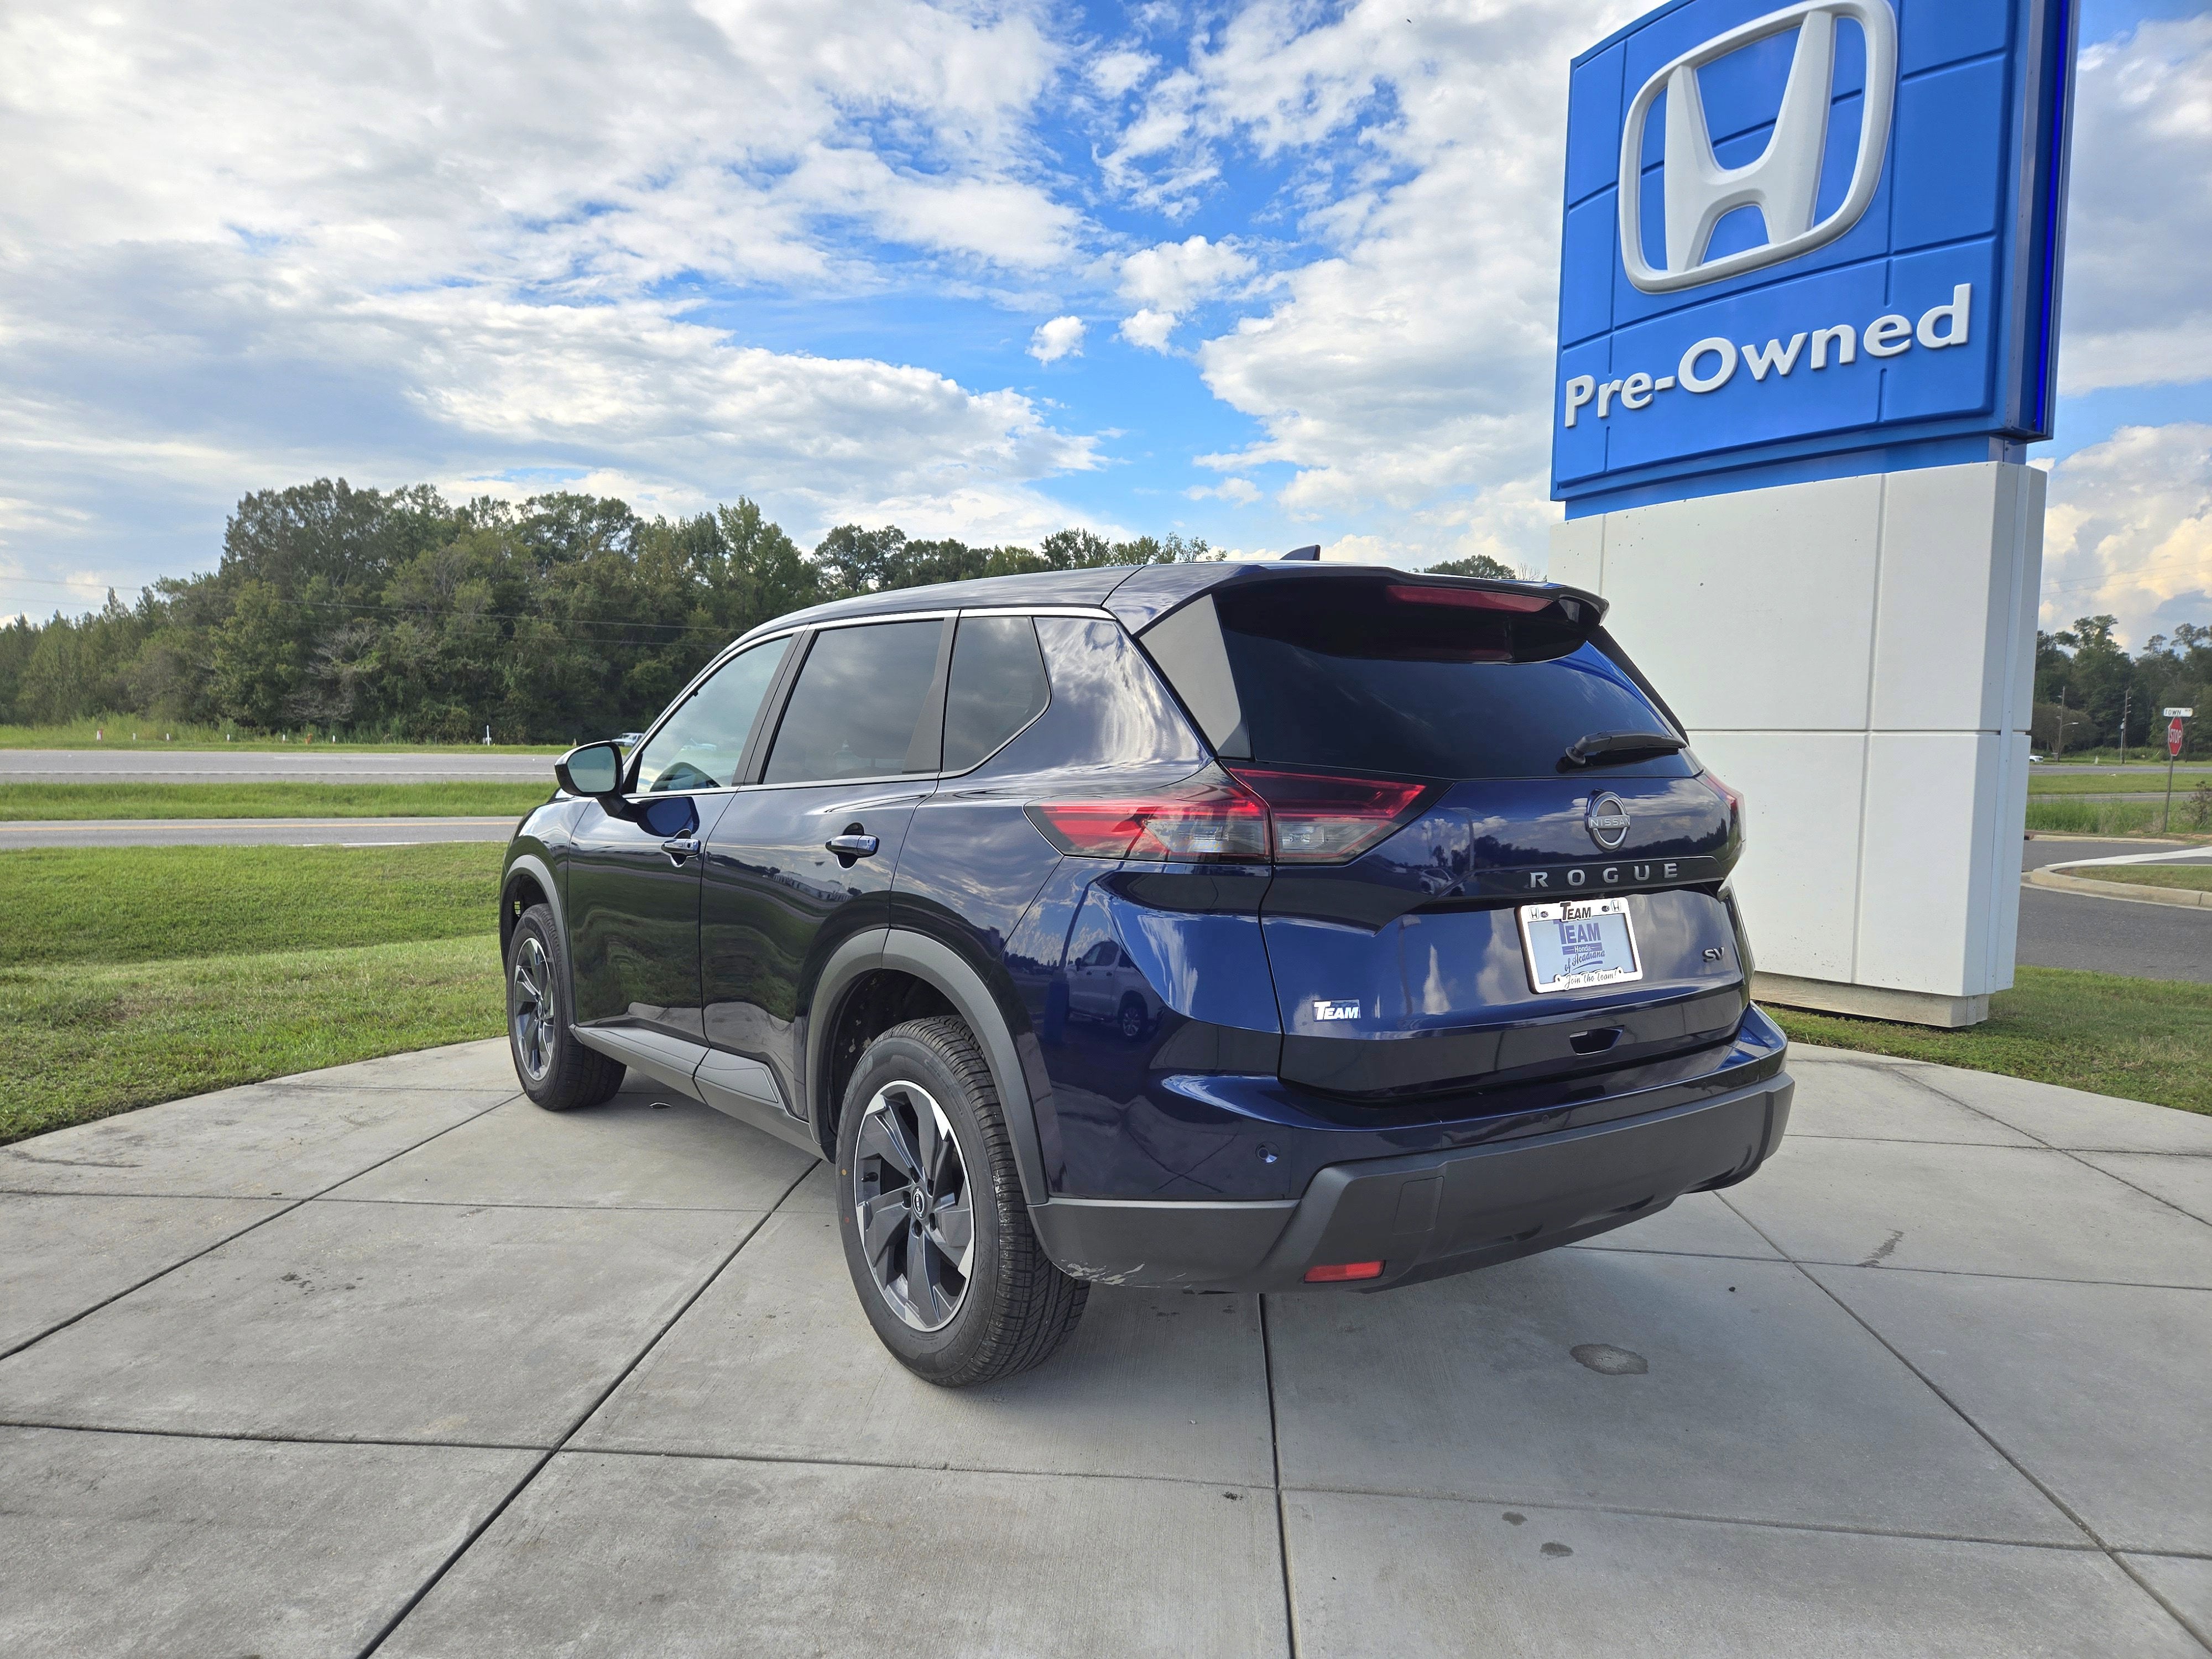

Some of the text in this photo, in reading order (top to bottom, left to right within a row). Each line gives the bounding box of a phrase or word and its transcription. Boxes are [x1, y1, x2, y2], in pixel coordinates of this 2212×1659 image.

[1565, 284, 1971, 427] Pre-Owned
[2170, 729, 2182, 744] STOP
[1590, 818, 1630, 827] NISSAN
[1530, 863, 1678, 888] ROGUE
[1574, 944, 1592, 953] Honda
[1704, 947, 1725, 962] SV
[1564, 958, 1572, 974] of
[1564, 974, 1581, 989] Join
